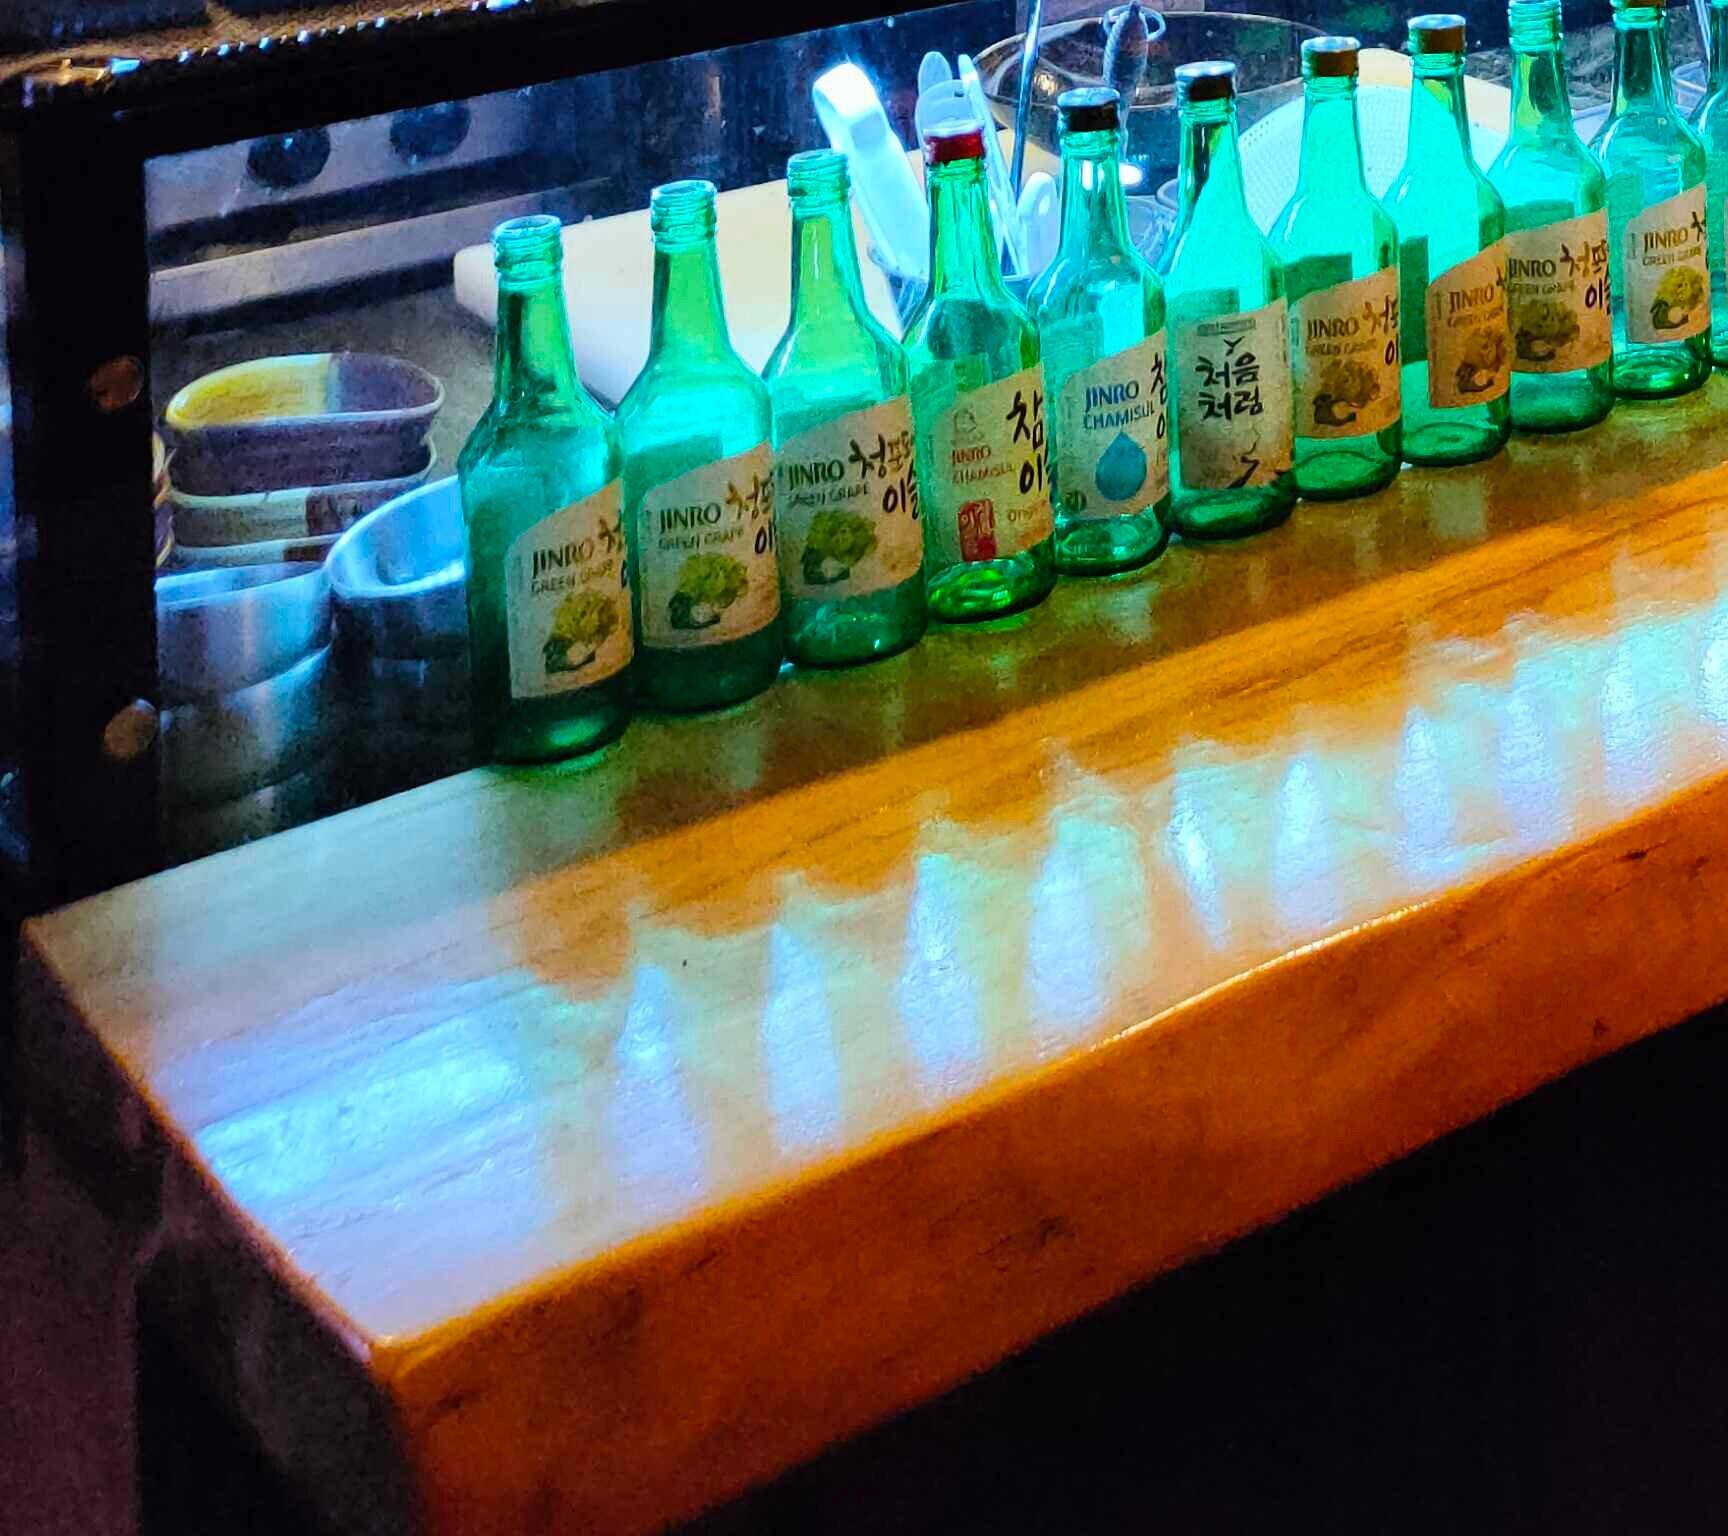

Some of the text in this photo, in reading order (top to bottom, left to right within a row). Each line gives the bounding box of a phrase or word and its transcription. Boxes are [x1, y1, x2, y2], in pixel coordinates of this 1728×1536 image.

[1643, 227, 1689, 255] JINRO
[1508, 256, 1557, 279] JINRO
[1448, 283, 1495, 313] JINRO
[1307, 316, 1360, 342] JINRO
[1195, 350, 1261, 389] 처음
[1084, 379, 1140, 413] JINRO
[1083, 400, 1155, 431] CHAMISUL
[788, 458, 845, 491] JINRO
[659, 502, 722, 534] JINRO
[532, 537, 594, 580] JINRO
